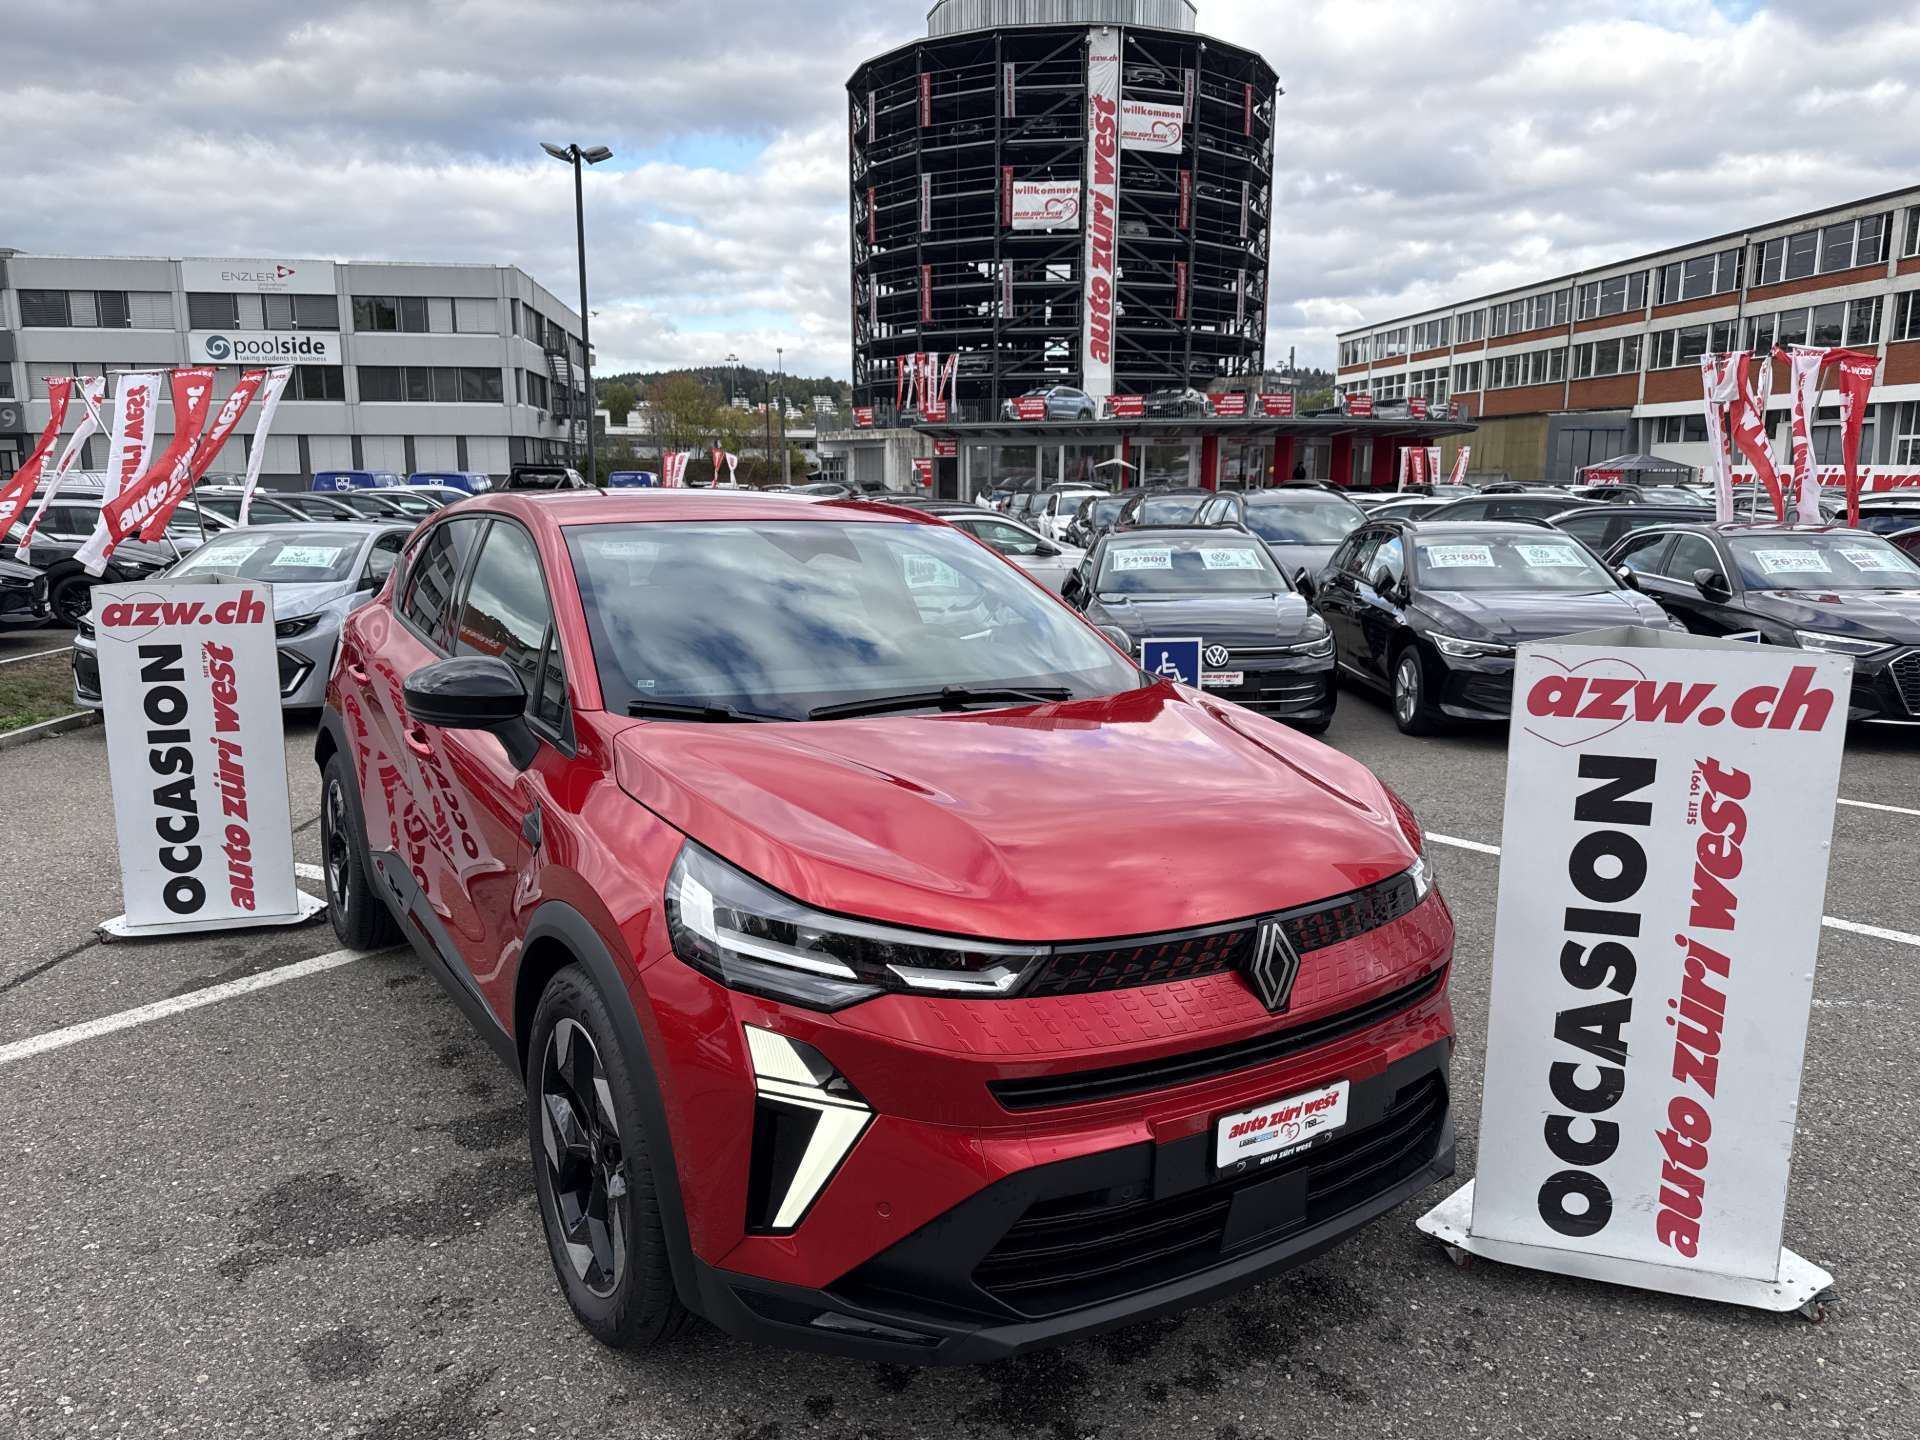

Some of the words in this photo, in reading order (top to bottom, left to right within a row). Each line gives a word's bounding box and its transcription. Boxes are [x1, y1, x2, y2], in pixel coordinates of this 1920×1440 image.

[1092, 93, 1117, 185] west
[1123, 105, 1182, 119] willkommen
[1014, 186, 1079, 195] willkommen
[1088, 188, 1114, 276] züri
[221, 272, 276, 282] ENZLER
[234, 336, 326, 360] poolside
[1087, 276, 1112, 365] auto
[240, 355, 261, 363] taking
[119, 480, 168, 532] auto
[101, 590, 266, 627] azw.ch
[200, 640, 241, 732] west
[1526, 666, 1835, 732] azw.ch
[138, 644, 207, 915] OCCASION
[209, 736, 249, 823] züri
[1689, 769, 1702, 797] 1991
[1687, 801, 1699, 825] SEIT
[1688, 756, 1752, 932] west
[220, 823, 257, 912] auto
[1537, 754, 1658, 1239] OCCASION
[1664, 934, 1732, 1101] züri
[1228, 1113, 1268, 1140] auto
[1268, 1101, 1304, 1127] züri
[1304, 1090, 1340, 1116] west
[1259, 1153, 1278, 1165] auto
[1296, 1141, 1313, 1153] west
[1655, 1096, 1712, 1260] auto
